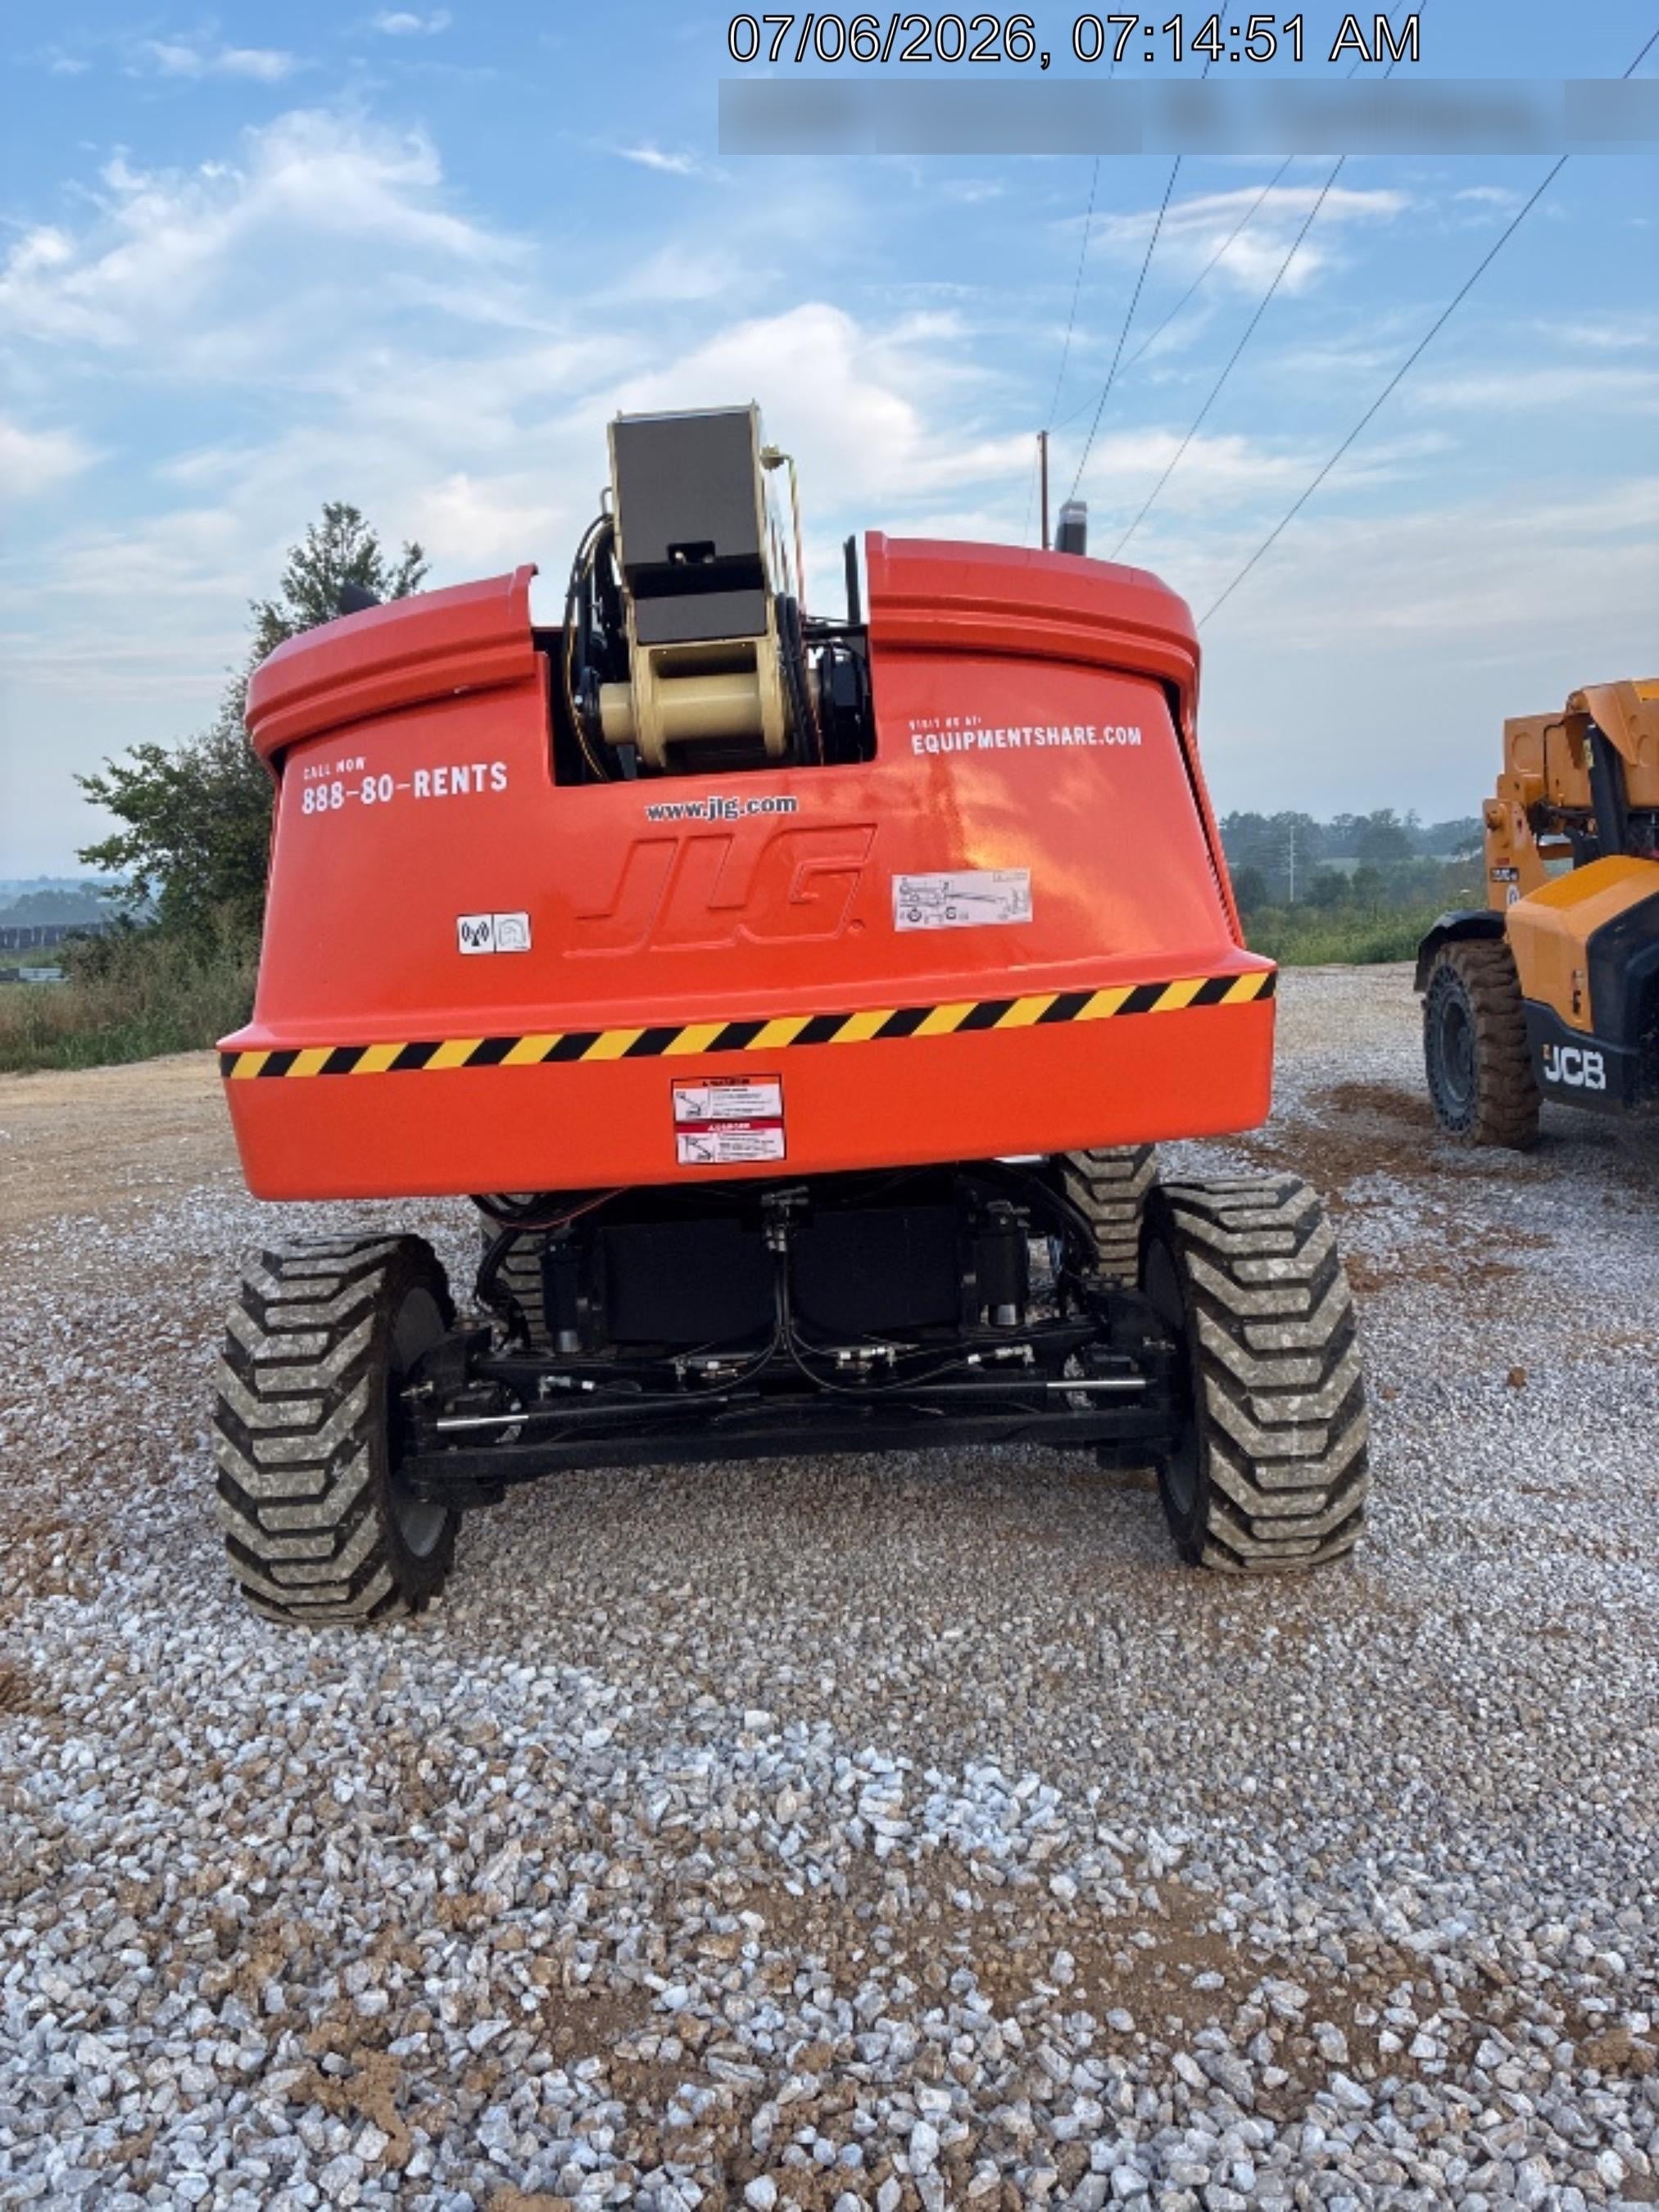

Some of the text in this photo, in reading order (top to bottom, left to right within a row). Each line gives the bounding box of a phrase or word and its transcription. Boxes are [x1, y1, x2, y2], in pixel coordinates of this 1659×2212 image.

[911, 727, 1141, 755] EQUIPMENTSHARE.COM
[303, 756, 366, 780] CALL NOW
[301, 761, 508, 814] 888-80-RENTS
[646, 796, 798, 821] www.jlg.com
[1543, 1044, 1606, 1090] JCB
